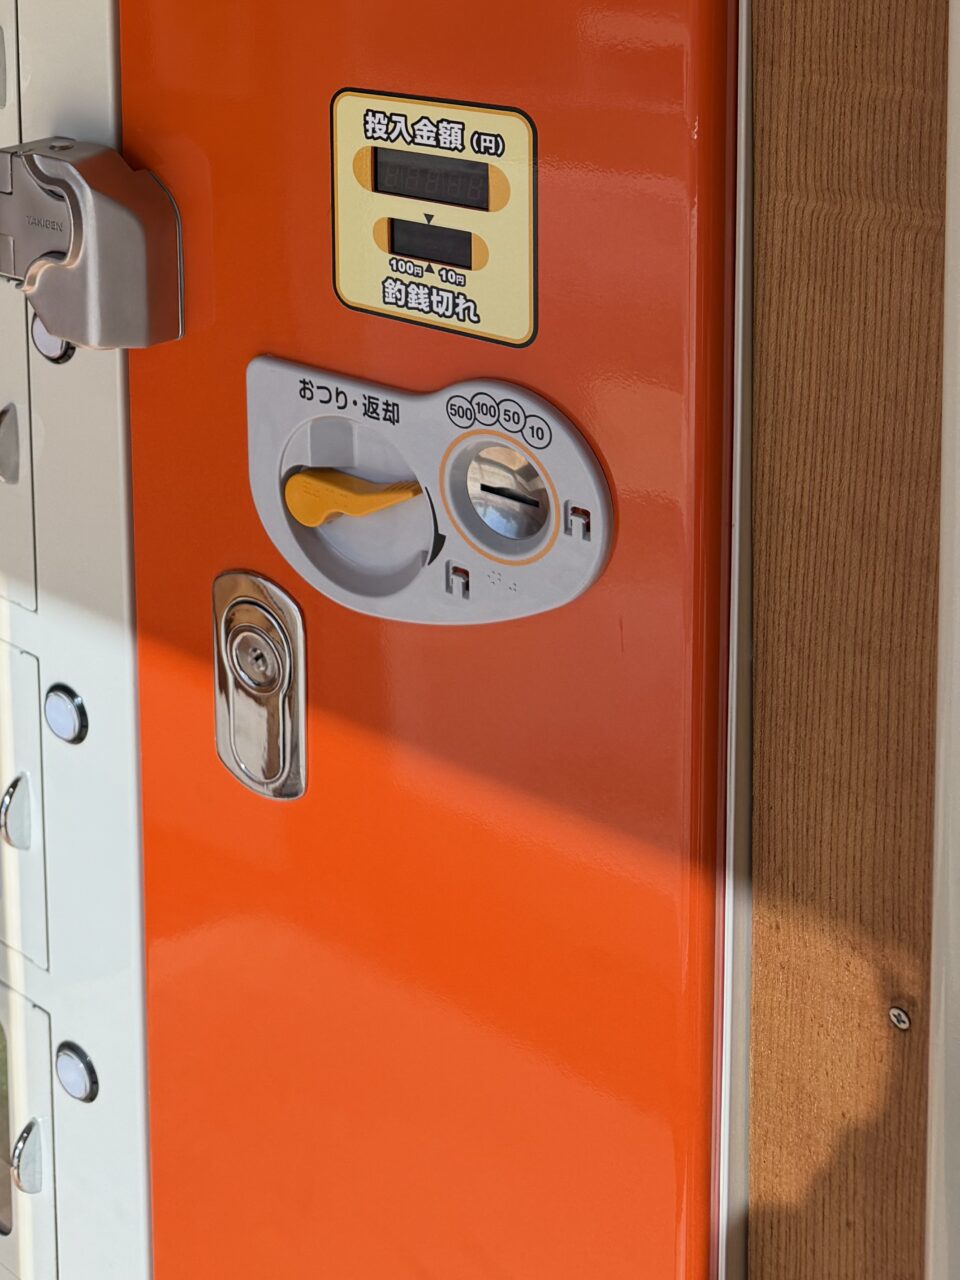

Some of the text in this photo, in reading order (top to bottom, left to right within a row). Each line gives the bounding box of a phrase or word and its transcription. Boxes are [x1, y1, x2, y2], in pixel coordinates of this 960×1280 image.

[389, 257, 466, 287] 100円 10円
[382, 278, 481, 324] 釣銭切れ
[298, 378, 400, 426] おつり・返却
[449, 400, 544, 441] 500 100 50 10
